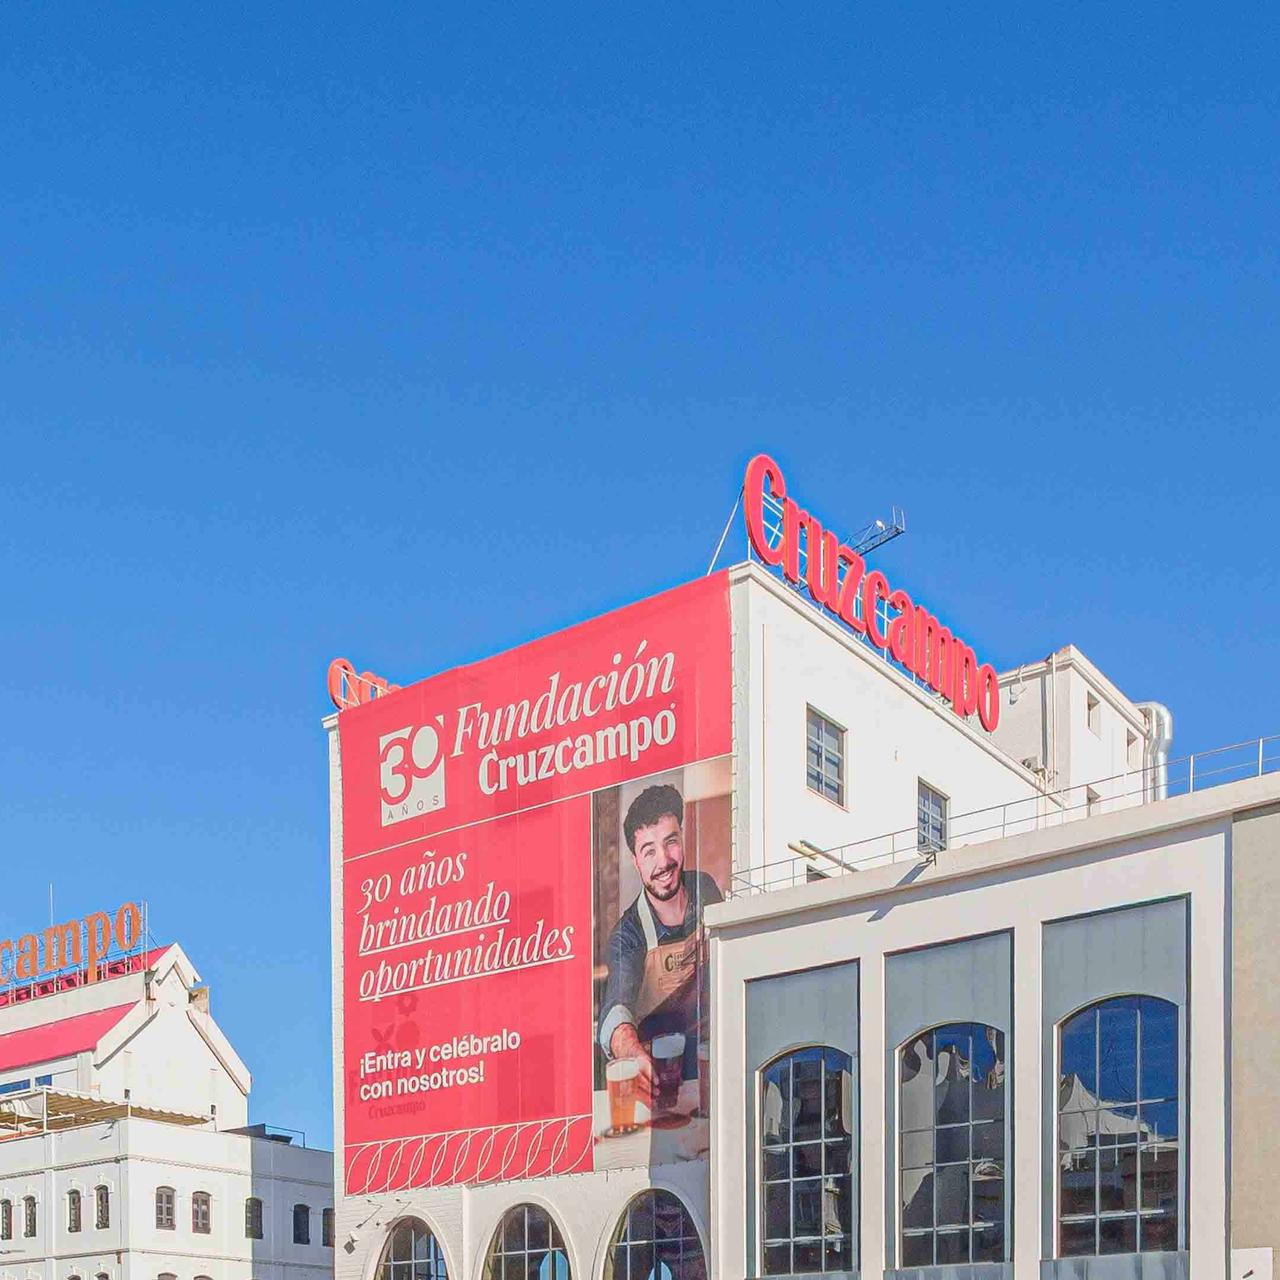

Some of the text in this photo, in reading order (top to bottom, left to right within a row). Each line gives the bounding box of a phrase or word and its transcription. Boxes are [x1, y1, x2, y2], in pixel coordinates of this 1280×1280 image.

[744, 453, 1000, 732] Cruzcampo
[450, 640, 675, 757] Fundación
[380, 717, 445, 806] 30
[478, 708, 676, 796] Cruzcampo
[386, 795, 440, 820] AÑOS
[357, 850, 468, 915] 30 años
[359, 881, 510, 953] brindando
[359, 919, 575, 1002] oportunidades
[359, 1028, 521, 1079] ¡Entra y celébralo
[359, 1080, 393, 1101] con
[397, 1060, 485, 1096] nosotros!
